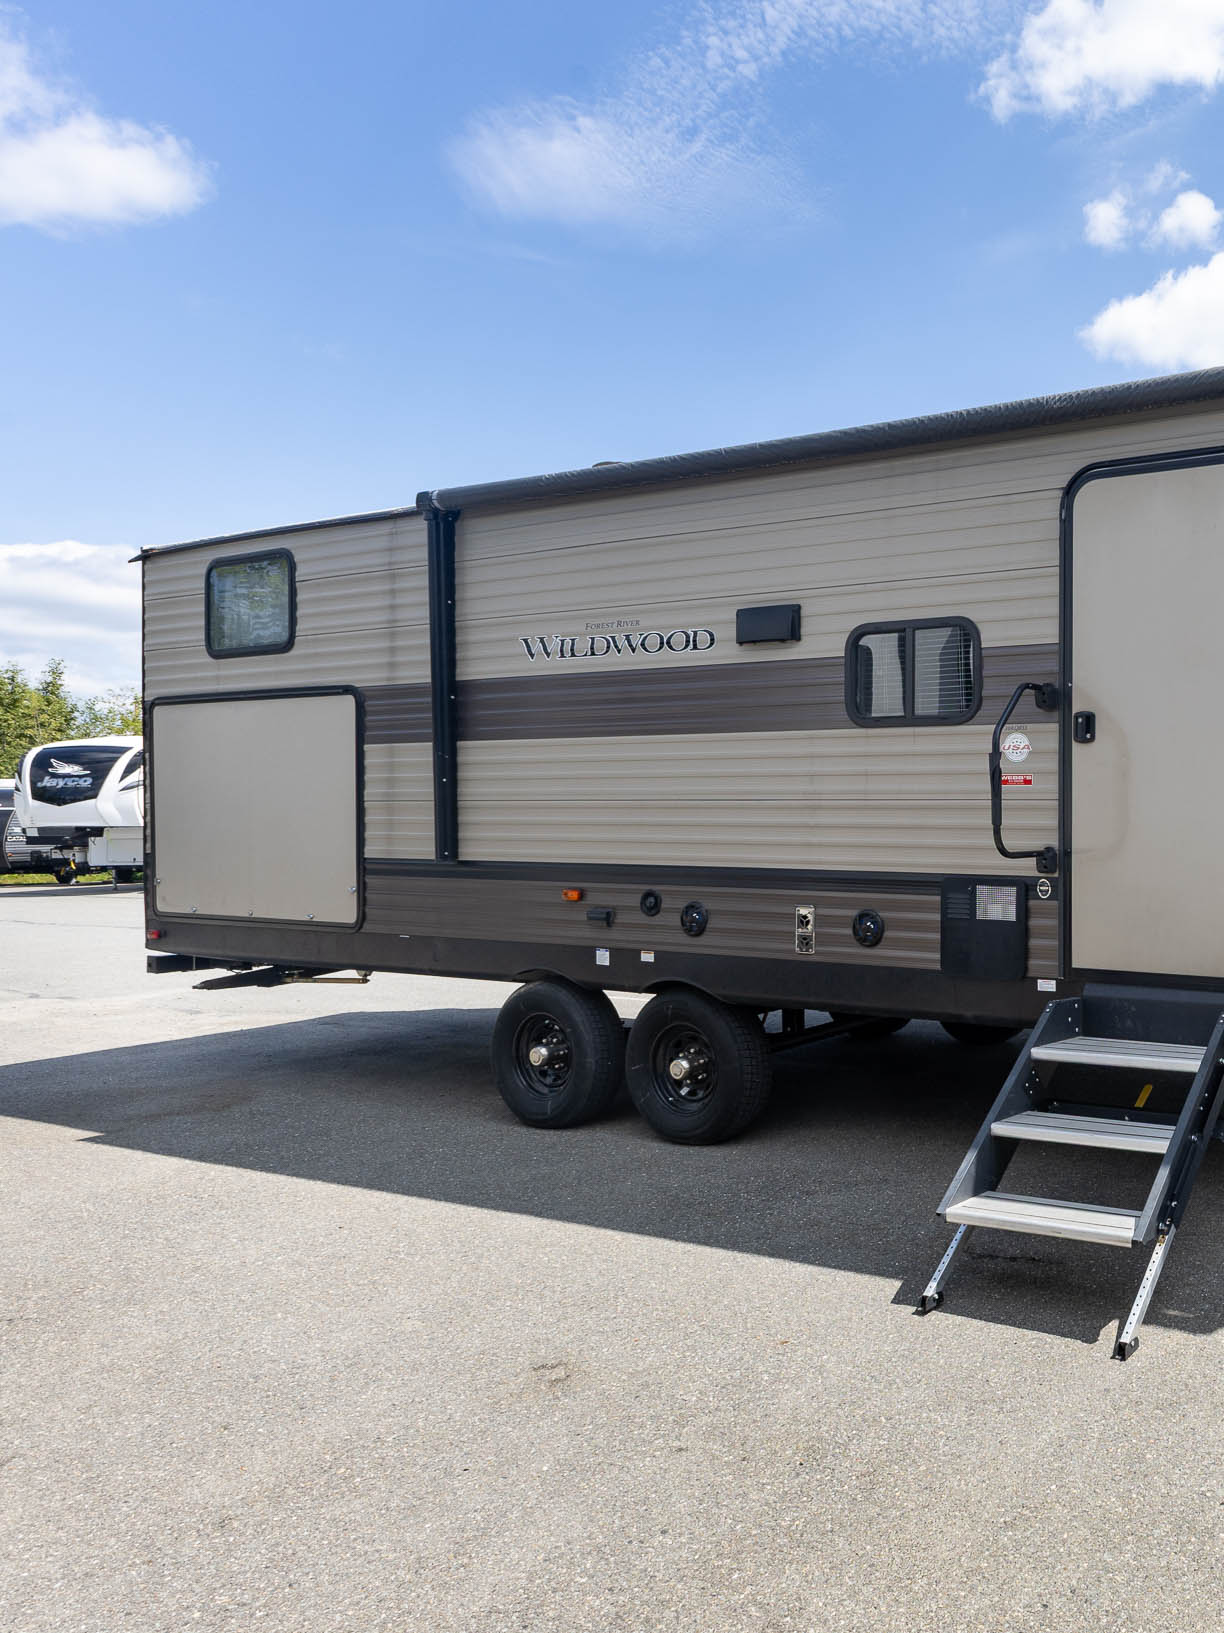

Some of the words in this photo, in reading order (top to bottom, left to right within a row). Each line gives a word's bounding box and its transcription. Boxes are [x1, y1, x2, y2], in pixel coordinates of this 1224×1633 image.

[585, 621, 615, 630] FOREST
[616, 619, 641, 629] RIVER
[520, 628, 716, 661] WILDWOOD
[37, 776, 93, 789] Jayco
